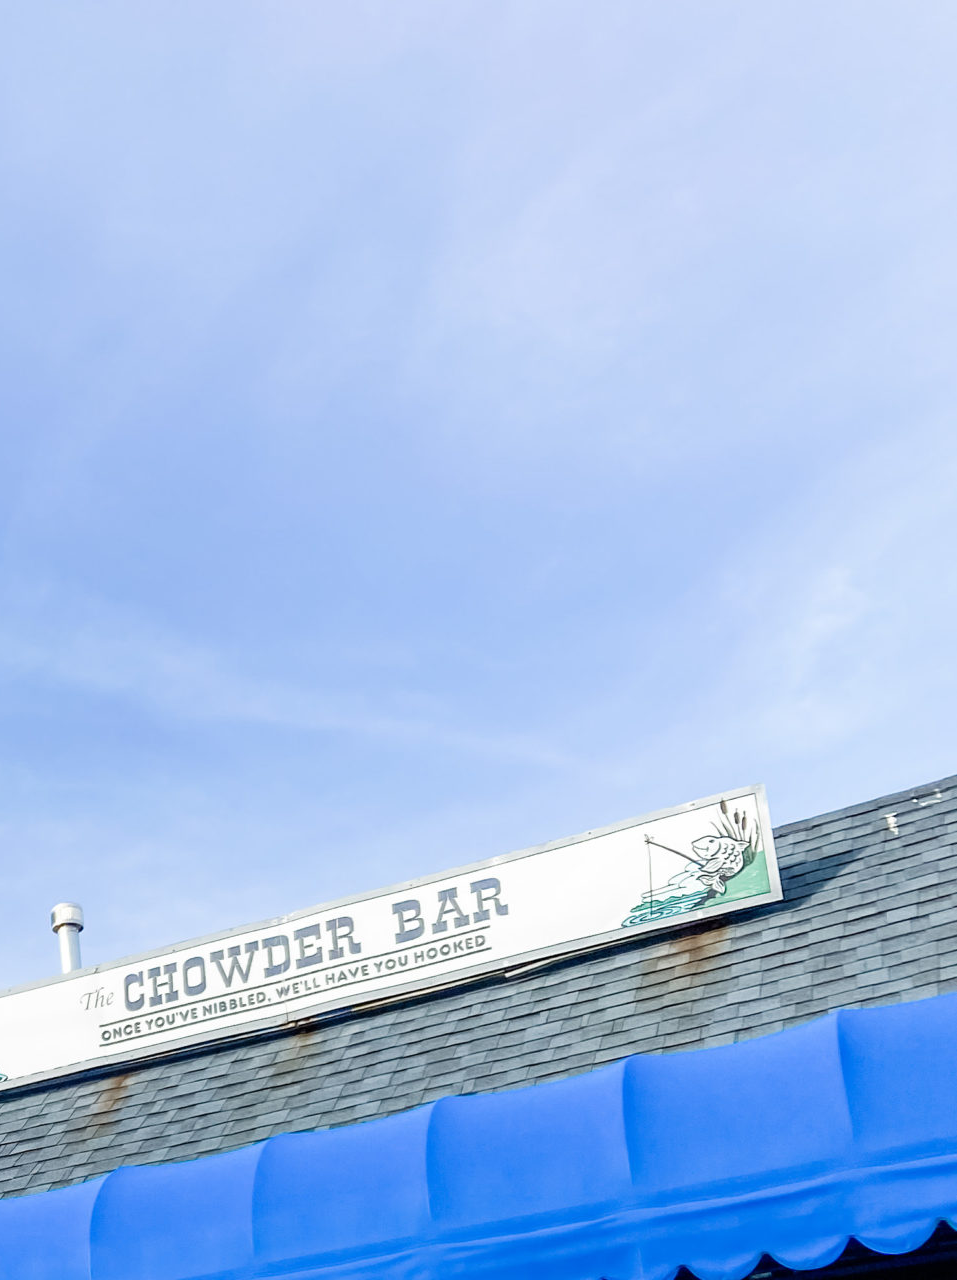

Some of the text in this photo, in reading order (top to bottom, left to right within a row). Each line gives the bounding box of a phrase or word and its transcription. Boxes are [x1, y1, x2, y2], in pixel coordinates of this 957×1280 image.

[80, 877, 508, 1011] The CHOWDER BAR
[101, 934, 486, 1041] ONCE YOU'VE NIBBLED, WE'LL HAVE YOU HOOKED
